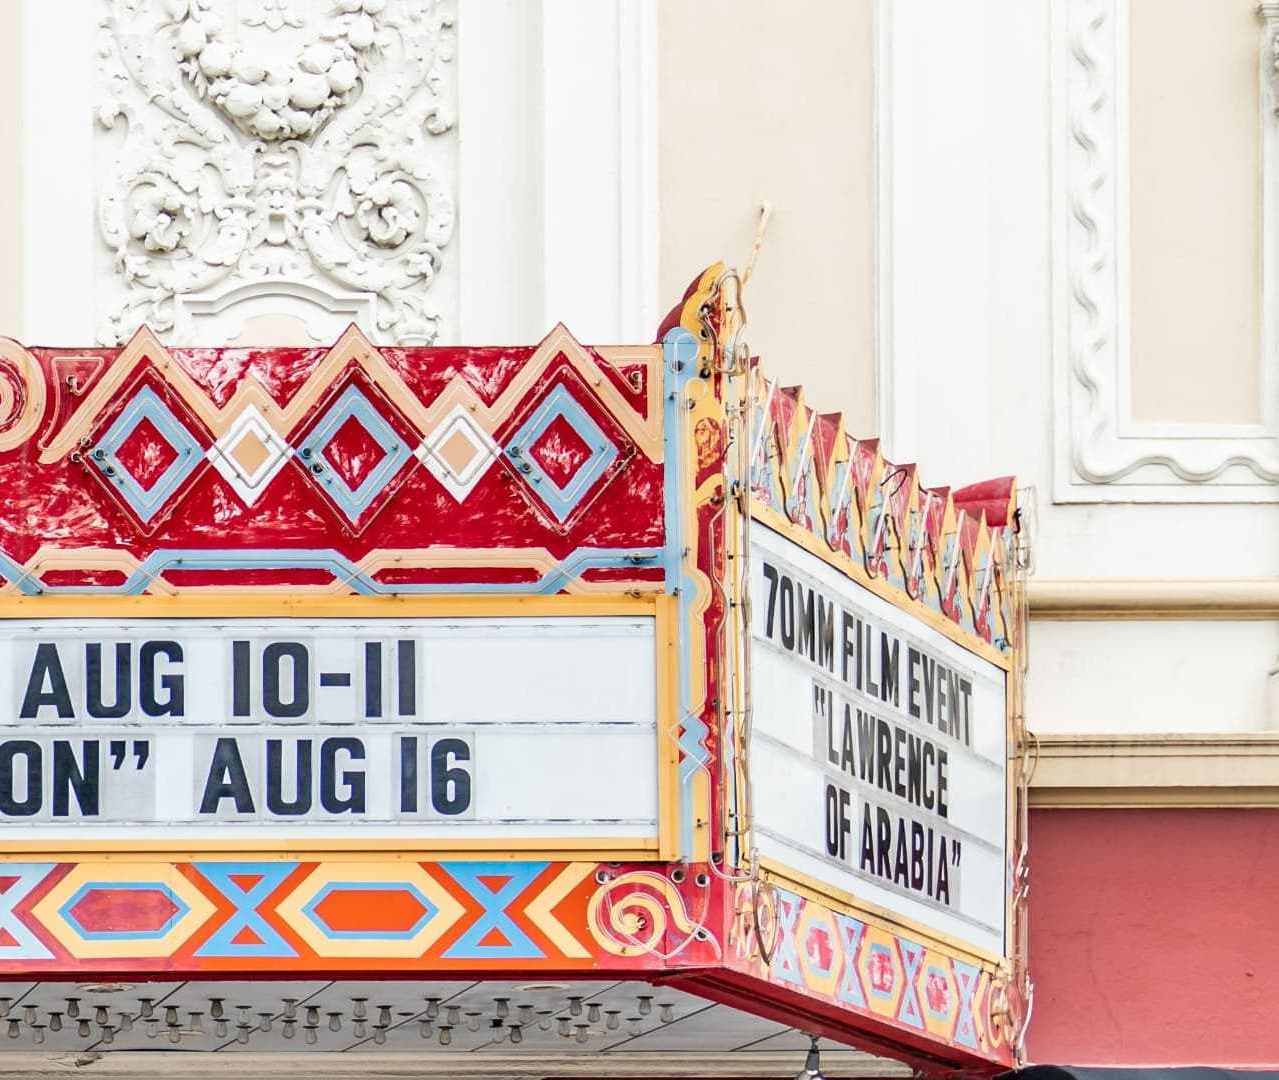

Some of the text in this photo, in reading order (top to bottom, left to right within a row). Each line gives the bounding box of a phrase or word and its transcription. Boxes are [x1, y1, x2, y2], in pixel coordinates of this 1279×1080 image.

[20, 641, 184, 718] AUG
[233, 640, 415, 717] 10-11
[762, 560, 973, 747] 70MM FILM EVENT
[200, 738, 365, 815] AUG
[401, 737, 470, 815] 16
[813, 684, 949, 819] "LAWRENCE
[825, 783, 962, 905] OF ARABIA"
